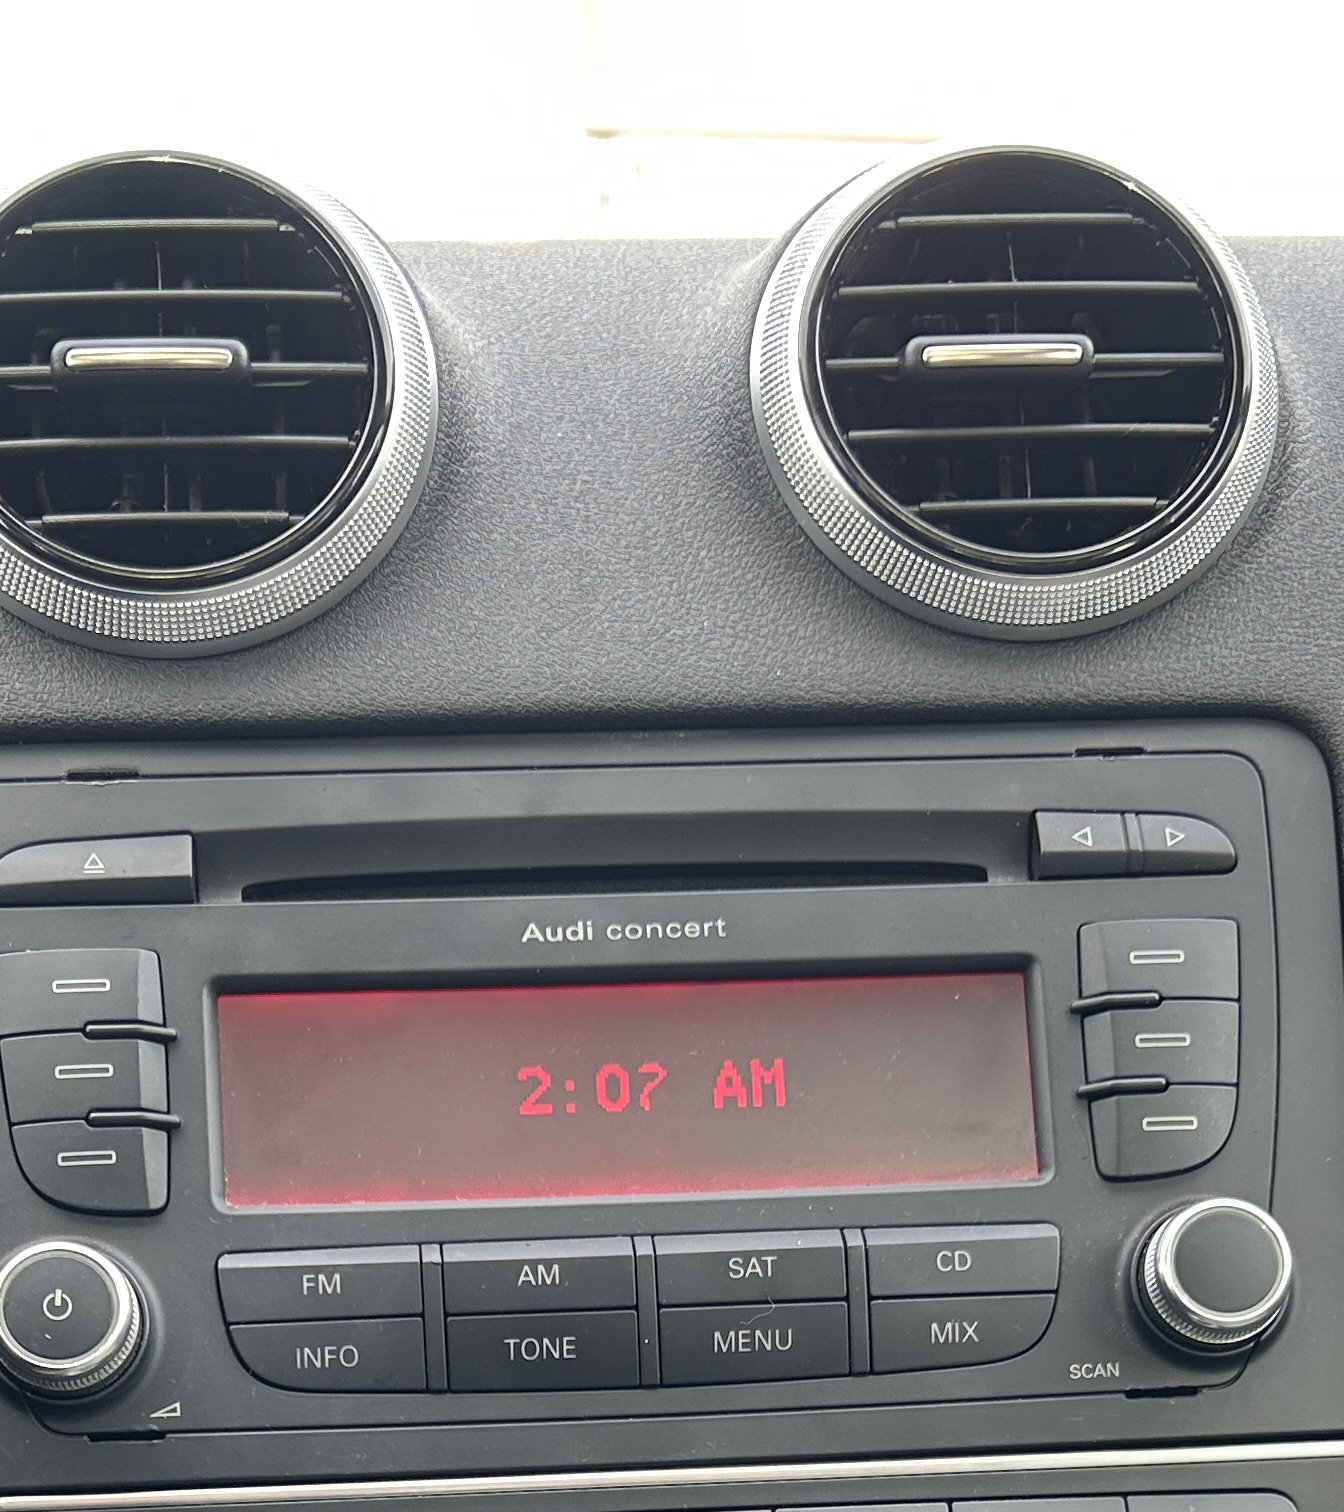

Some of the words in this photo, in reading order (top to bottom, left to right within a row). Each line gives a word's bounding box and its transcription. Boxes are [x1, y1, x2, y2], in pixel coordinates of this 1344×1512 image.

[521, 920, 594, 943] Audi
[606, 917, 727, 941] concert
[713, 1058, 787, 1109] AM
[727, 1256, 778, 1280] SAT
[936, 1250, 972, 1273] CD
[302, 1273, 342, 1296] FM
[516, 1263, 561, 1288] AM
[712, 1329, 794, 1355] MENU
[930, 1322, 980, 1345] MIX
[294, 1345, 360, 1371] INFO
[504, 1336, 577, 1362] TONE
[1069, 1362, 1120, 1379] SCAN
